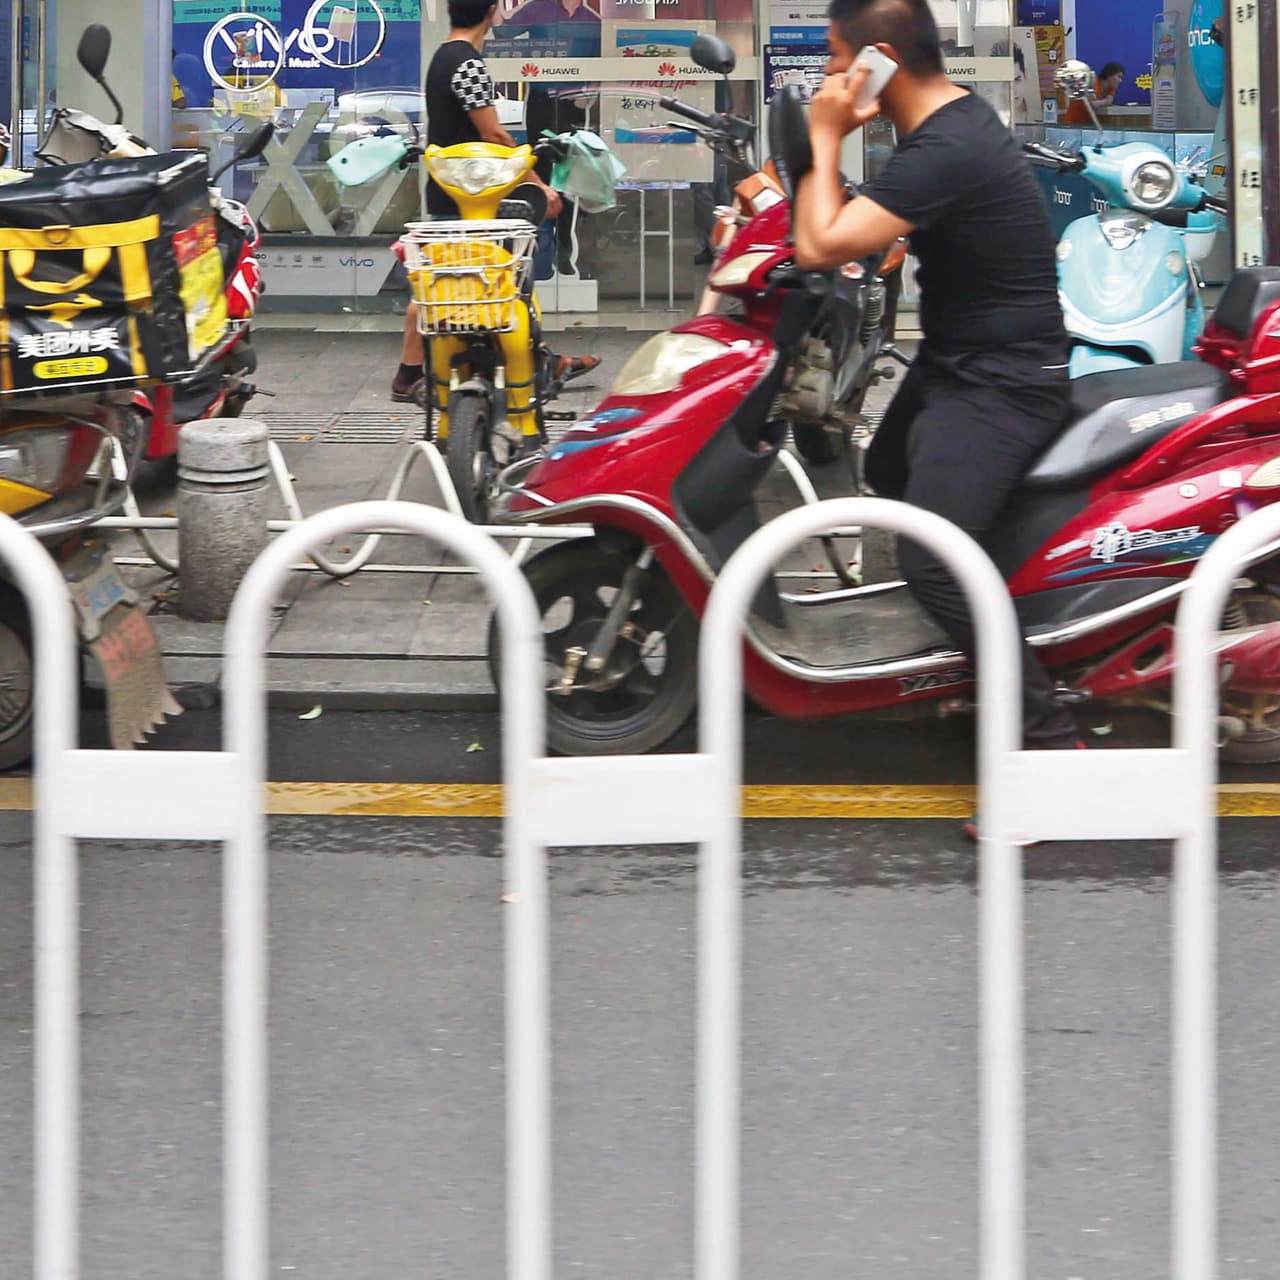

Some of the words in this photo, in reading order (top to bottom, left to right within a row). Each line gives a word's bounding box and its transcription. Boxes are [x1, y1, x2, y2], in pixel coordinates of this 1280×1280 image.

[289, 57, 321, 69] Music
[542, 67, 580, 75] HUAWEI
[678, 67, 714, 75] HUAW
[944, 66, 976, 75] UAWEI
[339, 256, 375, 267] vivo
[18, 327, 120, 358] 美团外卖
